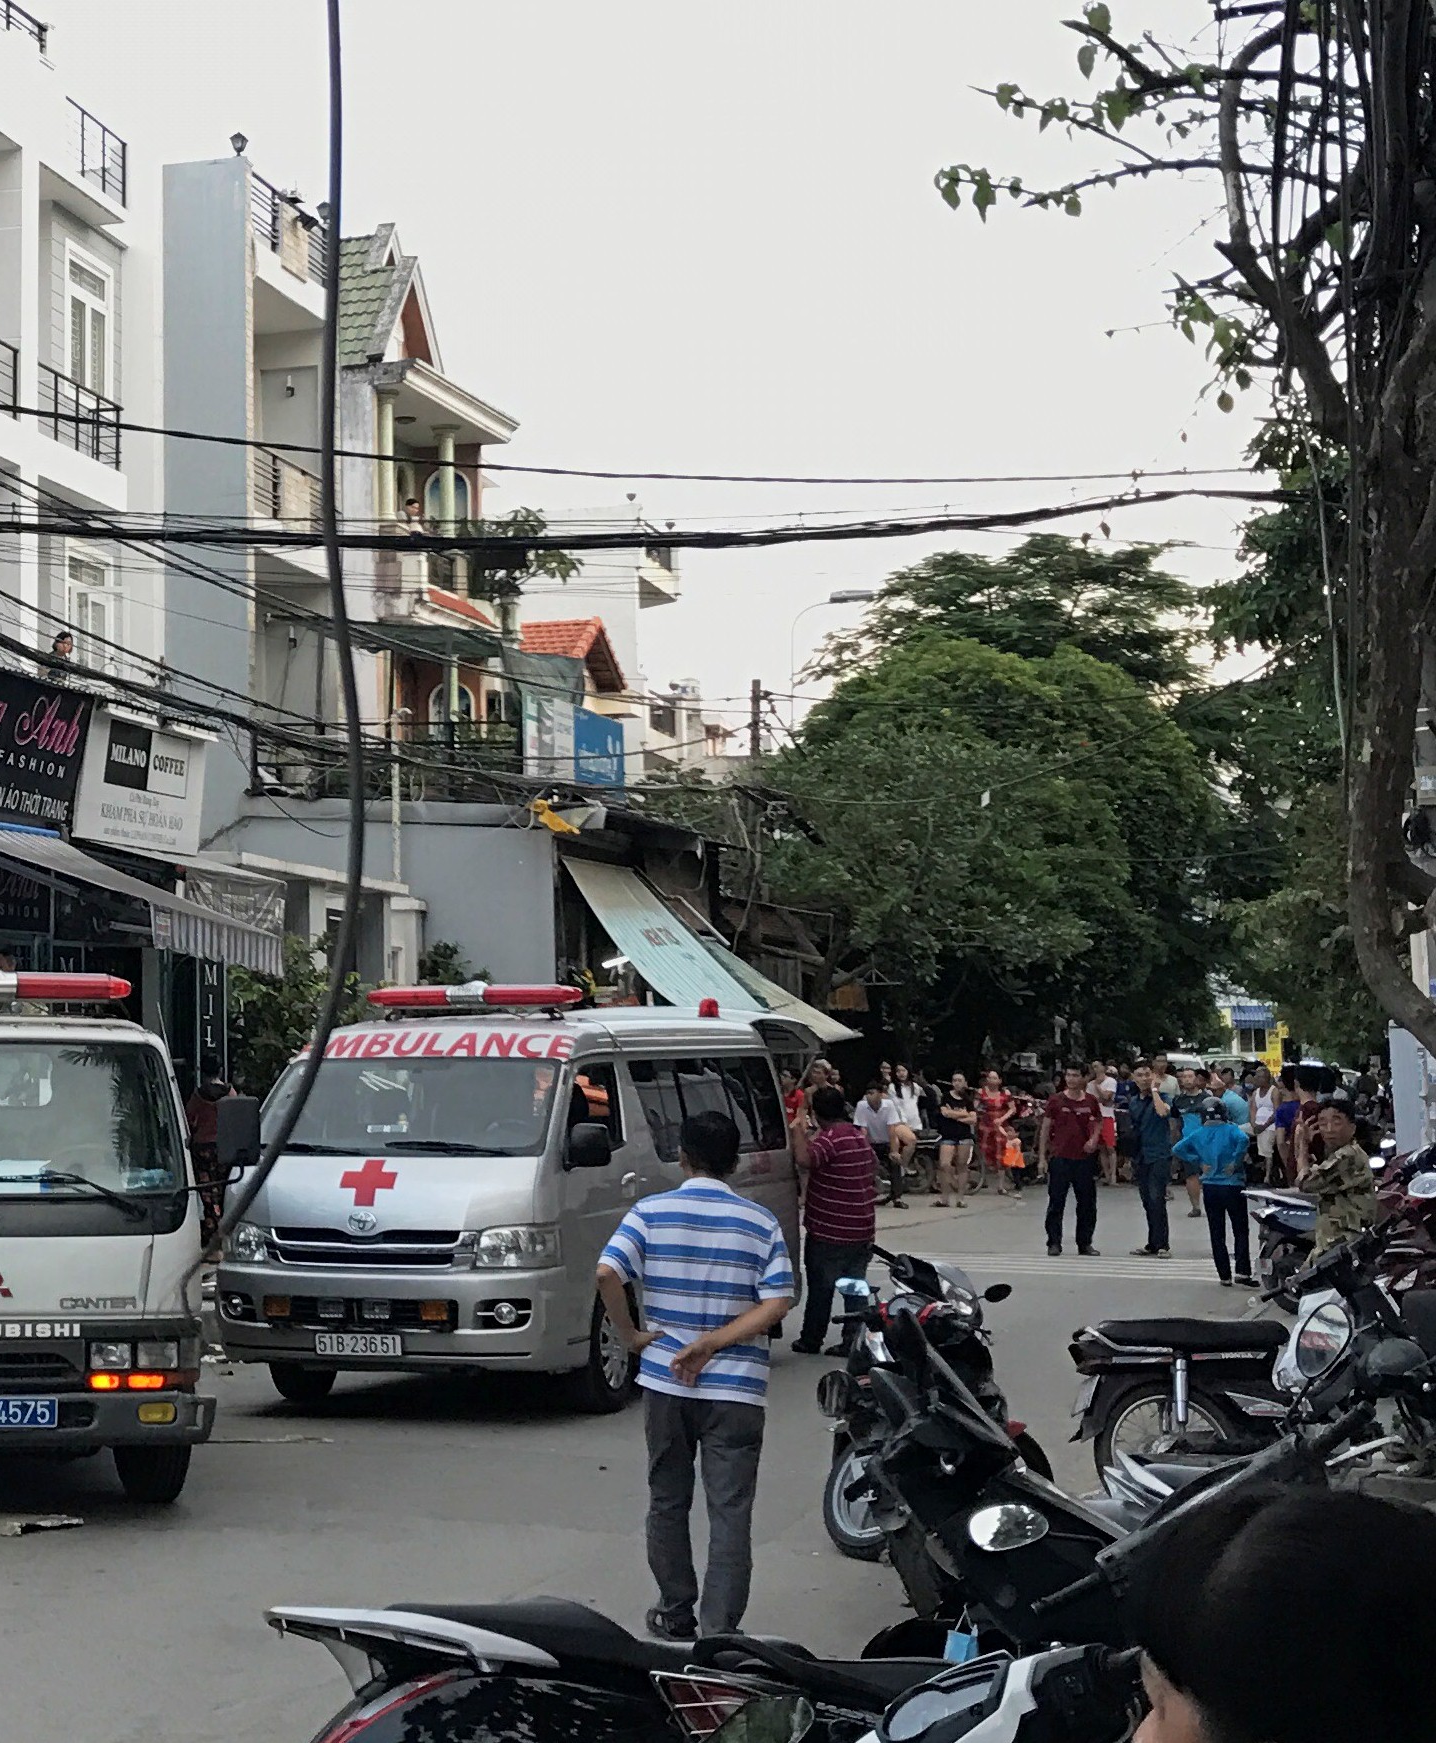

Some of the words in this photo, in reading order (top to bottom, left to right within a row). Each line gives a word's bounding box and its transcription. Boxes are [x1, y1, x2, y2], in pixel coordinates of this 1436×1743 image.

[14, 694, 85, 757] Anh
[110, 743, 147, 768] MILANO
[153, 754, 185, 776] COFFEE
[4, 782, 20, 810] ÁO
[41, 796, 69, 821] TRANG
[297, 1031, 579, 1060] MBULANCE
[59, 1296, 137, 1309] CANTER
